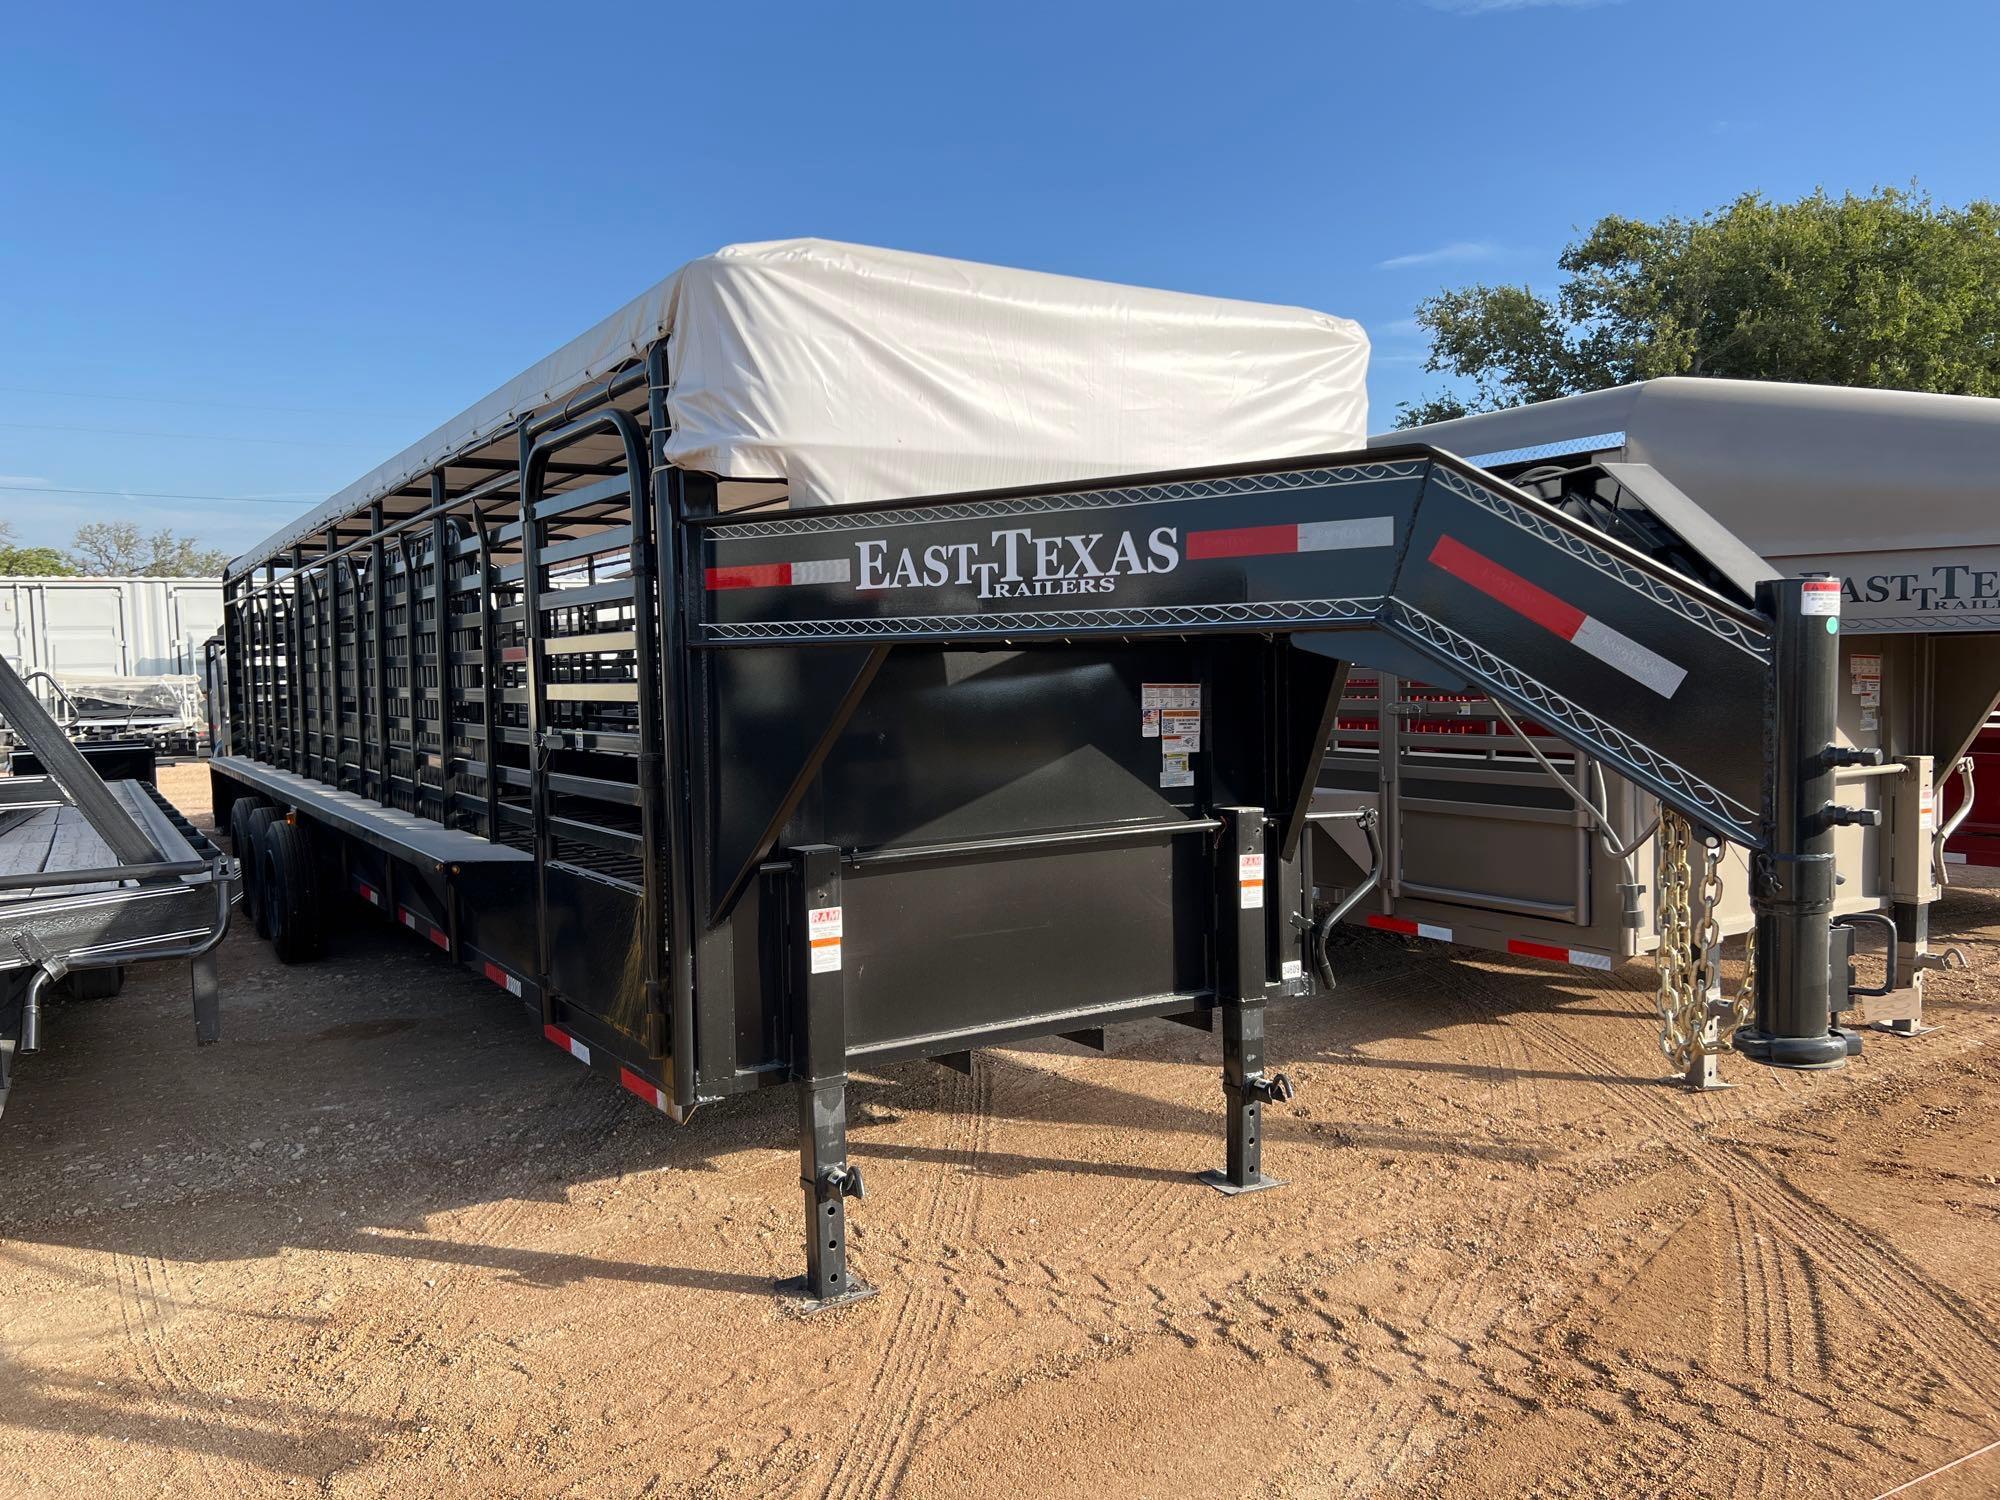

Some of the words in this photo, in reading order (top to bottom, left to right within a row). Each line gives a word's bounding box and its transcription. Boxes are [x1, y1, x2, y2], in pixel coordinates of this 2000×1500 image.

[855, 540, 979, 591] EAST
[991, 526, 1180, 582] TEXAS
[971, 562, 1116, 599] TRAILERS
[1799, 571, 1919, 603] AST
[1911, 587, 2000, 611] TRAIL
